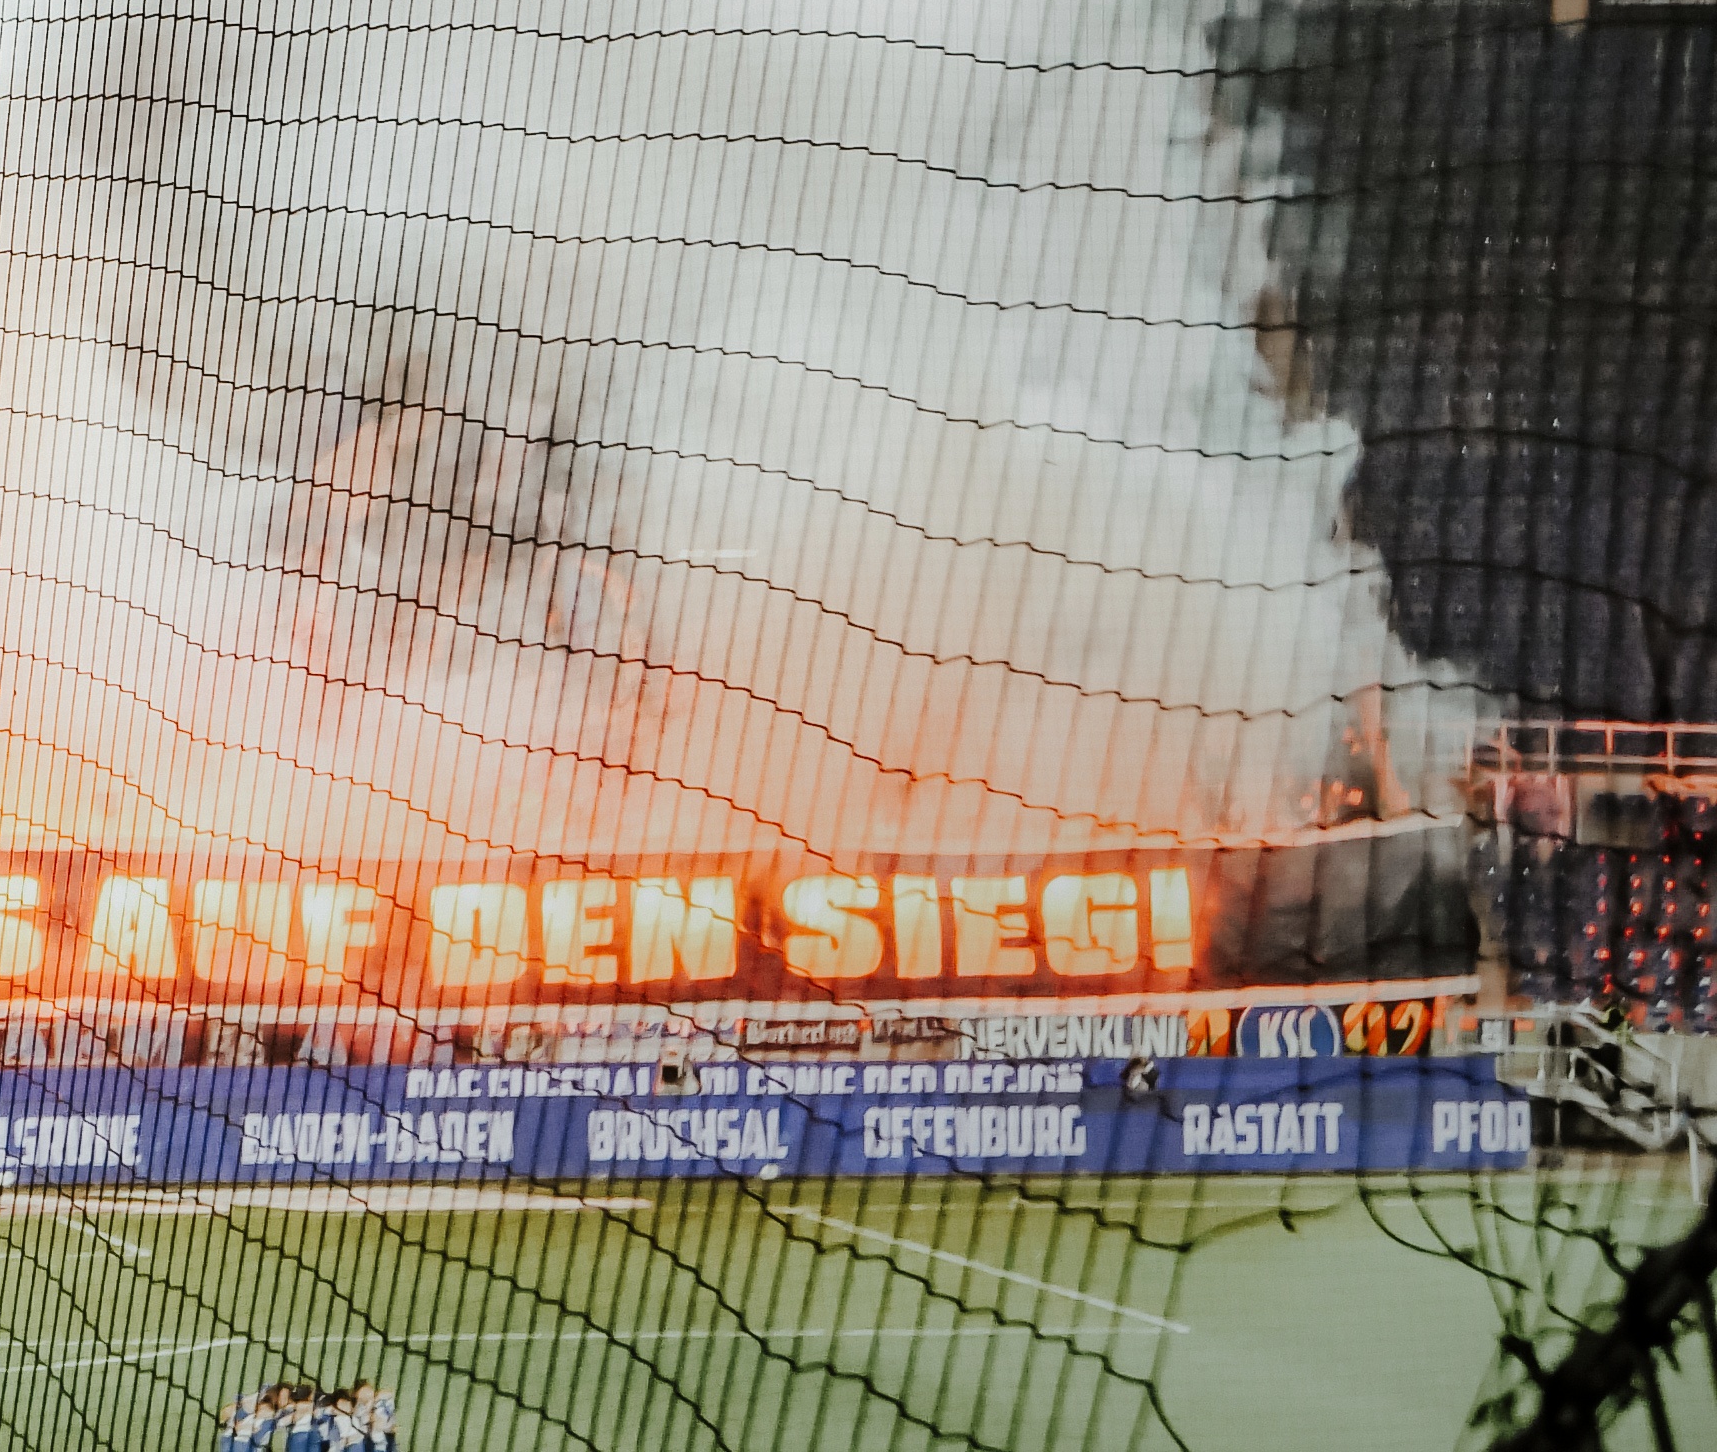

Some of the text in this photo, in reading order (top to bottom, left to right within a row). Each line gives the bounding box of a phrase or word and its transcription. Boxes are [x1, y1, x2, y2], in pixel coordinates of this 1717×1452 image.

[82, 873, 379, 988] AUF
[431, 875, 736, 985] DEN
[781, 867, 1193, 979] SIEG!
[241, 1110, 516, 1165] BADEN-BADEN
[588, 1105, 788, 1161] BRUCHSAL
[863, 1104, 1087, 1160] OFFENBURG
[1183, 1101, 1343, 1155] RASTATT
[1432, 1099, 1530, 1154] PFOR
